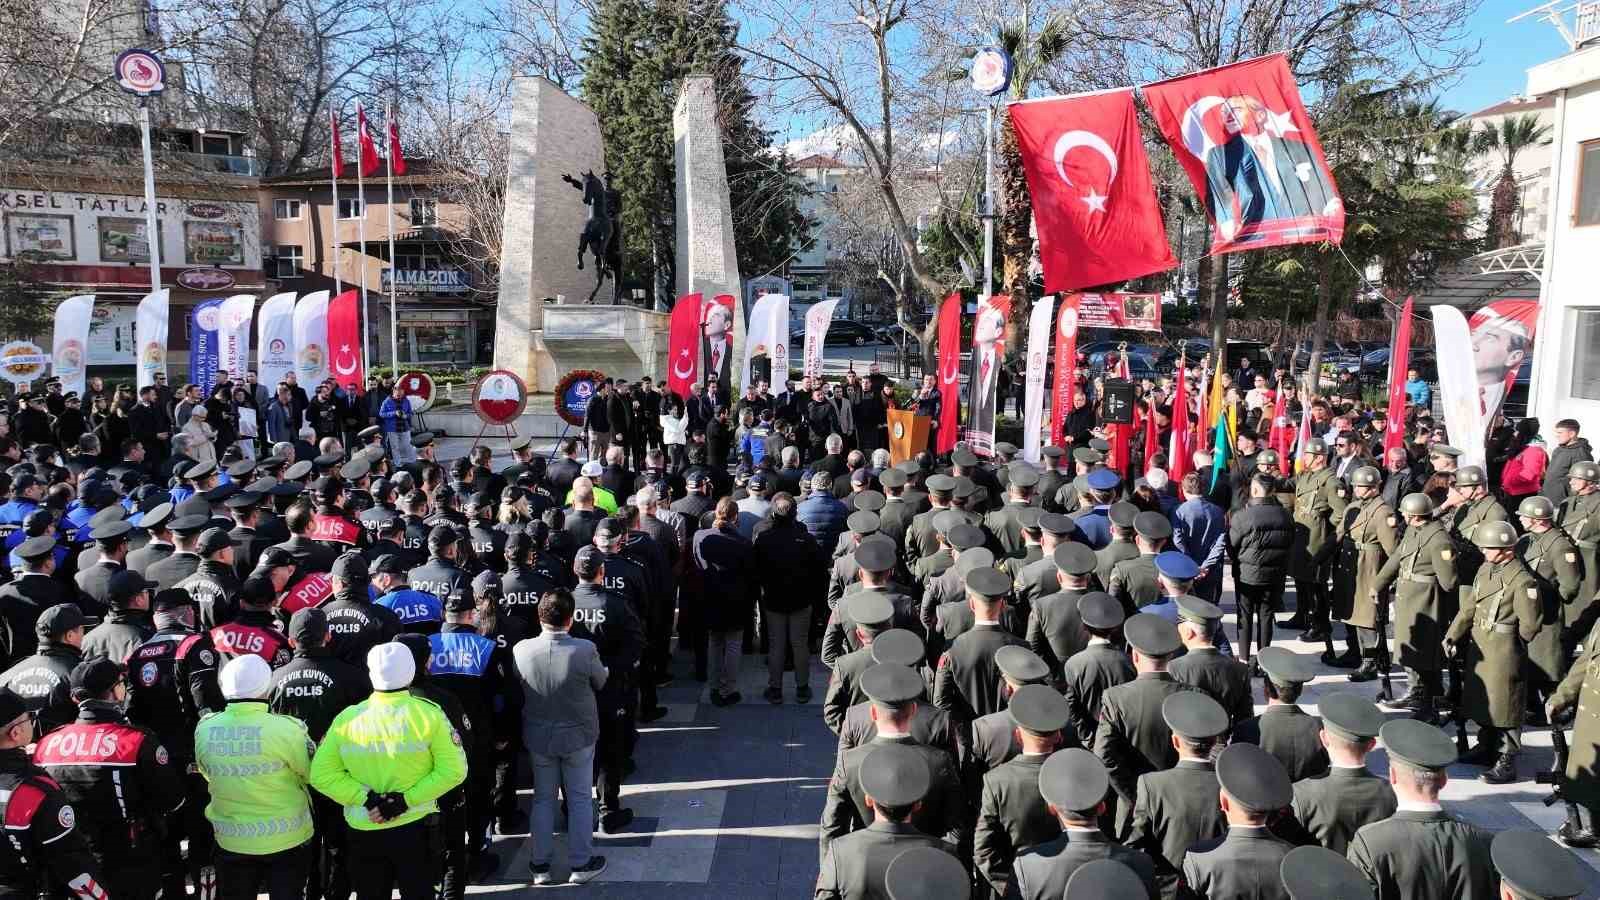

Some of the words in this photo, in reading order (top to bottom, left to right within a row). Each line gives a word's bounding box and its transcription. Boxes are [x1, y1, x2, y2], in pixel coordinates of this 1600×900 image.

[396, 269, 459, 285] AMAZON
[573, 608, 606, 623] OLiS
[303, 669, 334, 688] KUVVET
